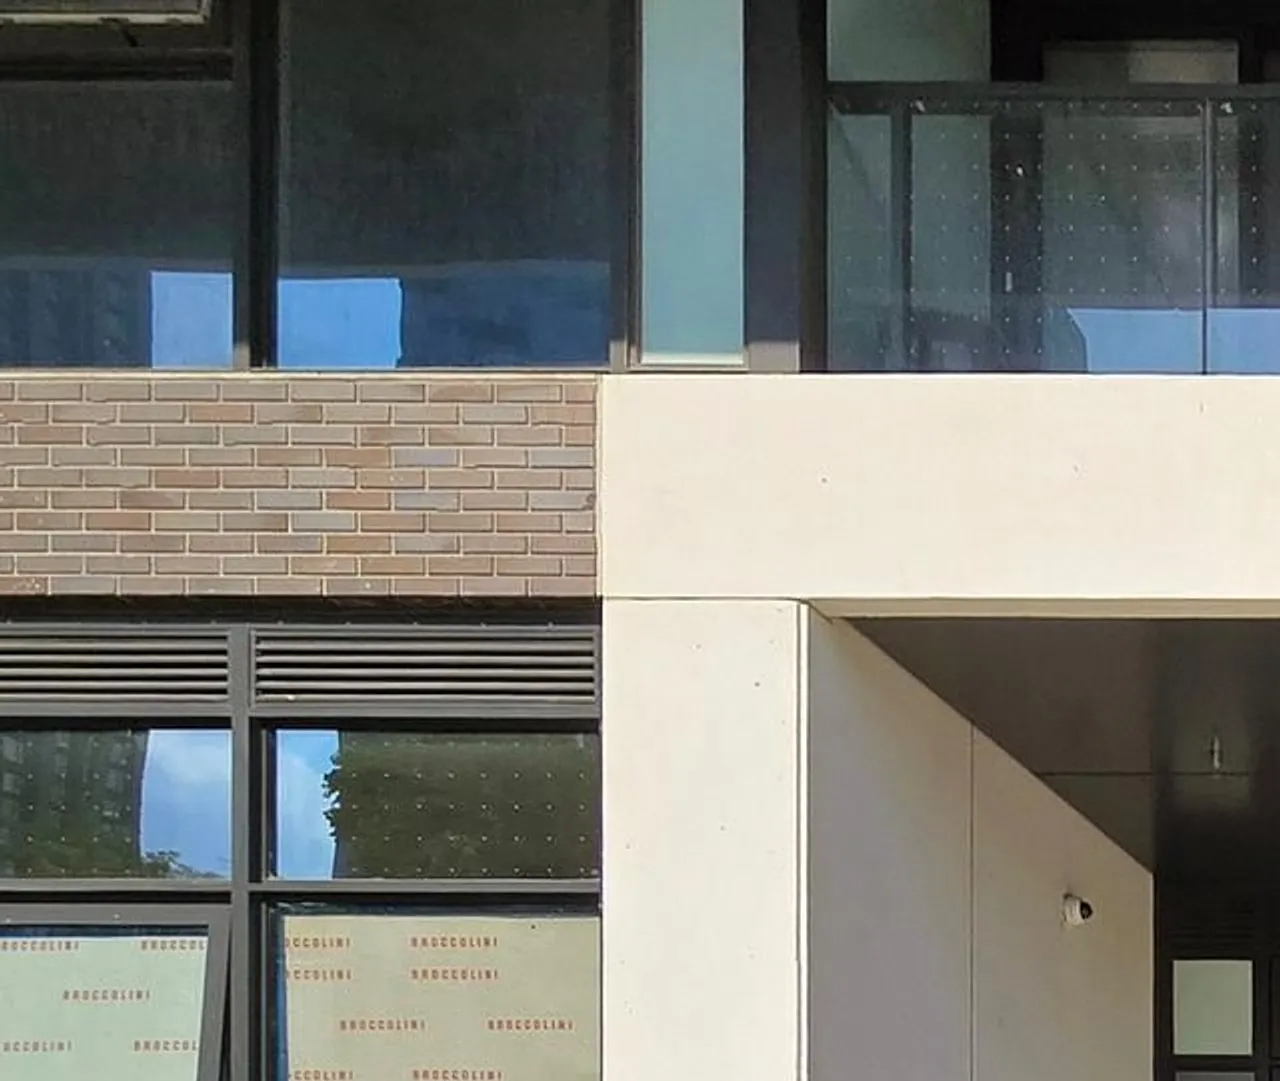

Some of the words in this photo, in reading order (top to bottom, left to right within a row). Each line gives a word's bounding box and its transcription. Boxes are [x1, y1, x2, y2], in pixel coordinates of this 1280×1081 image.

[411, 937, 498, 948] BROCCOLINI
[411, 970, 498, 980] BROCCOLINI
[63, 990, 149, 1000] BROCCOLINI
[340, 1020, 425, 1030] BROCCOLINI
[488, 1020, 573, 1030] BROCCOLINI
[287, 1070, 353, 1081] CCOLINI
[413, 1070, 502, 1080] BROCCOLINI
